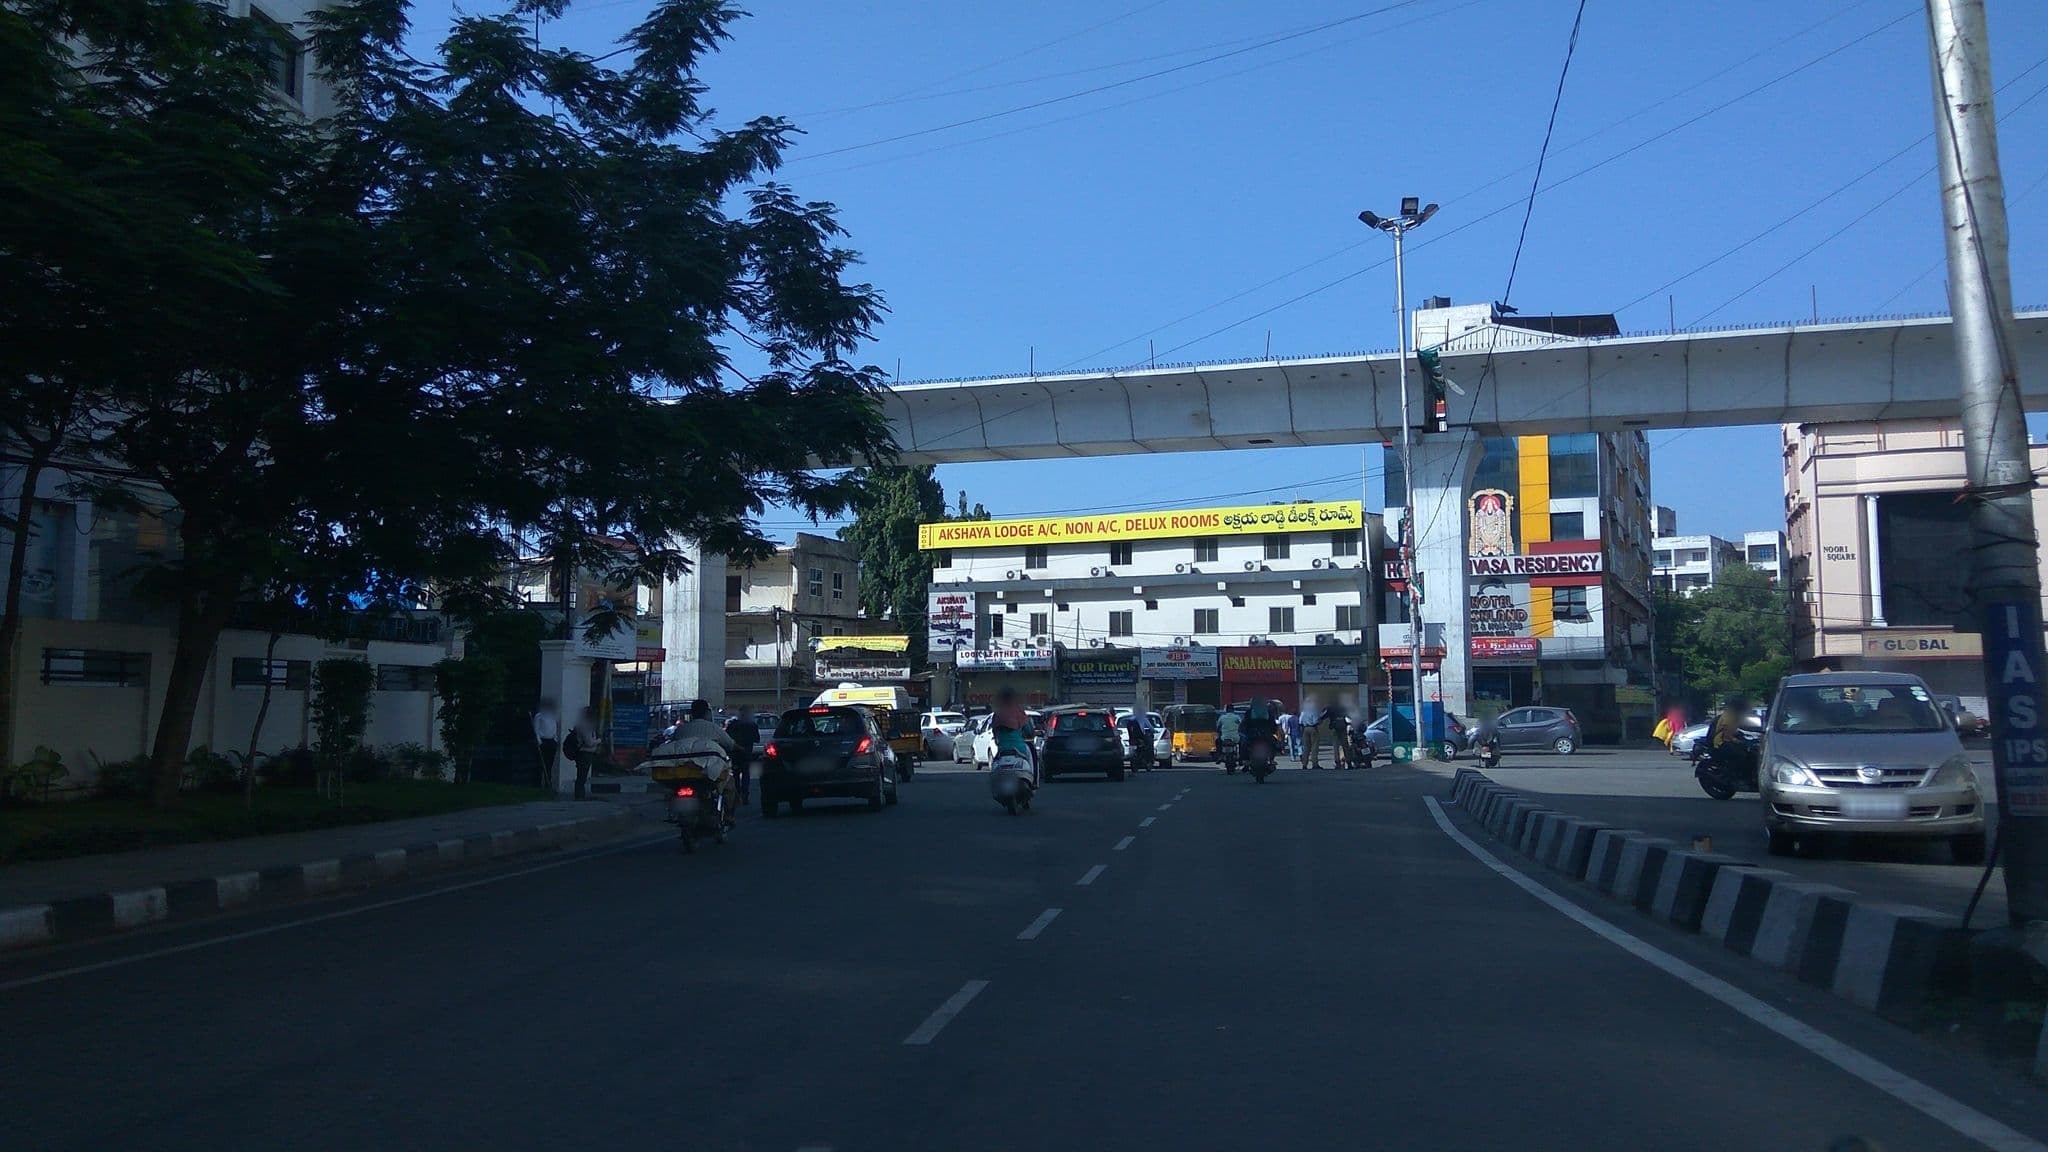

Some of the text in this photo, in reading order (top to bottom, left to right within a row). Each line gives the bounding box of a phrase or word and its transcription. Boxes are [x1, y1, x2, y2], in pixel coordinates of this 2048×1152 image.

[938, 514, 1219, 540] AKSHAYA LODGE A/C, NON A/C, DELUX ROOMS
[1223, 512, 1258, 531] అక్షయ
[1823, 545, 1848, 553] NOORI
[1827, 553, 1856, 561] SQUARE
[1469, 555, 1599, 575] IVASA RESIDENCY
[1884, 639, 1950, 650] GLOBAL
[1097, 661, 1136, 672] Travels
[1224, 656, 1292, 670] APSARA Footwear
